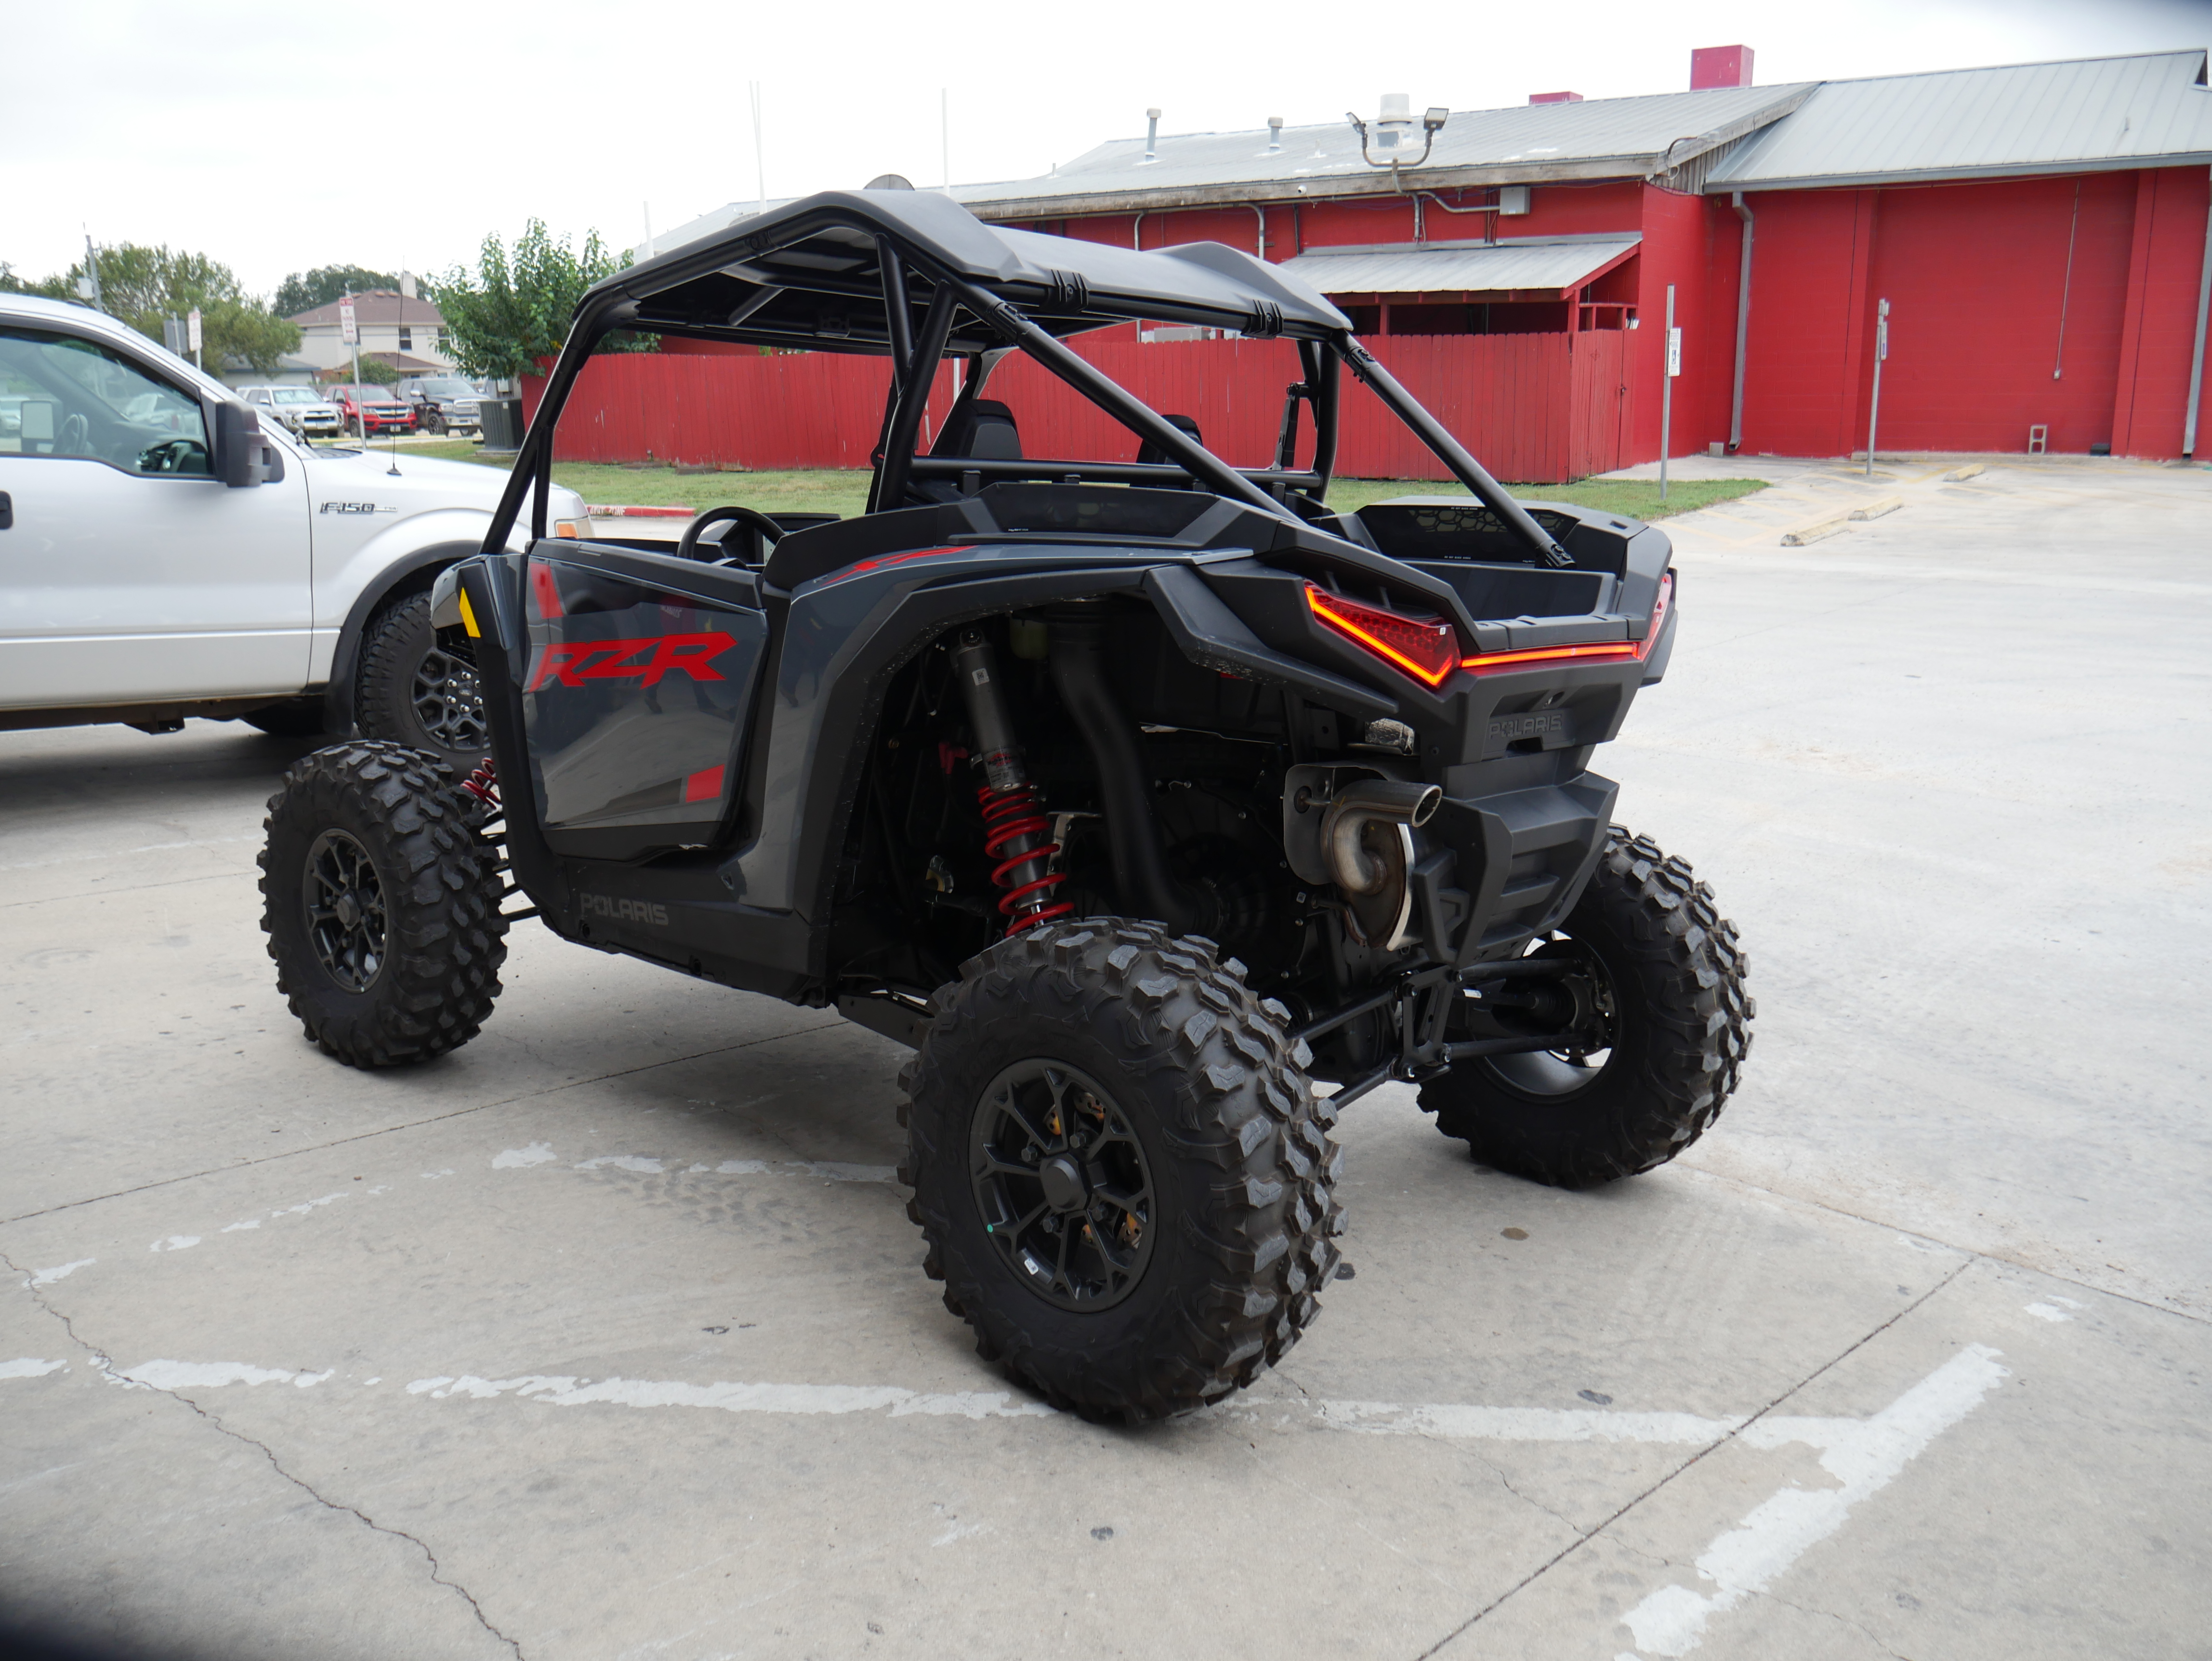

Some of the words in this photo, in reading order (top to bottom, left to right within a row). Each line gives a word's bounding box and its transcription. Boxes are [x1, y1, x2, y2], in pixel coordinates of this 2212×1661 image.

[320, 501, 376, 514] F-150
[528, 631, 737, 693] RZR
[1489, 714, 1562, 739] POLARIS
[580, 893, 669, 926] POLARIS
